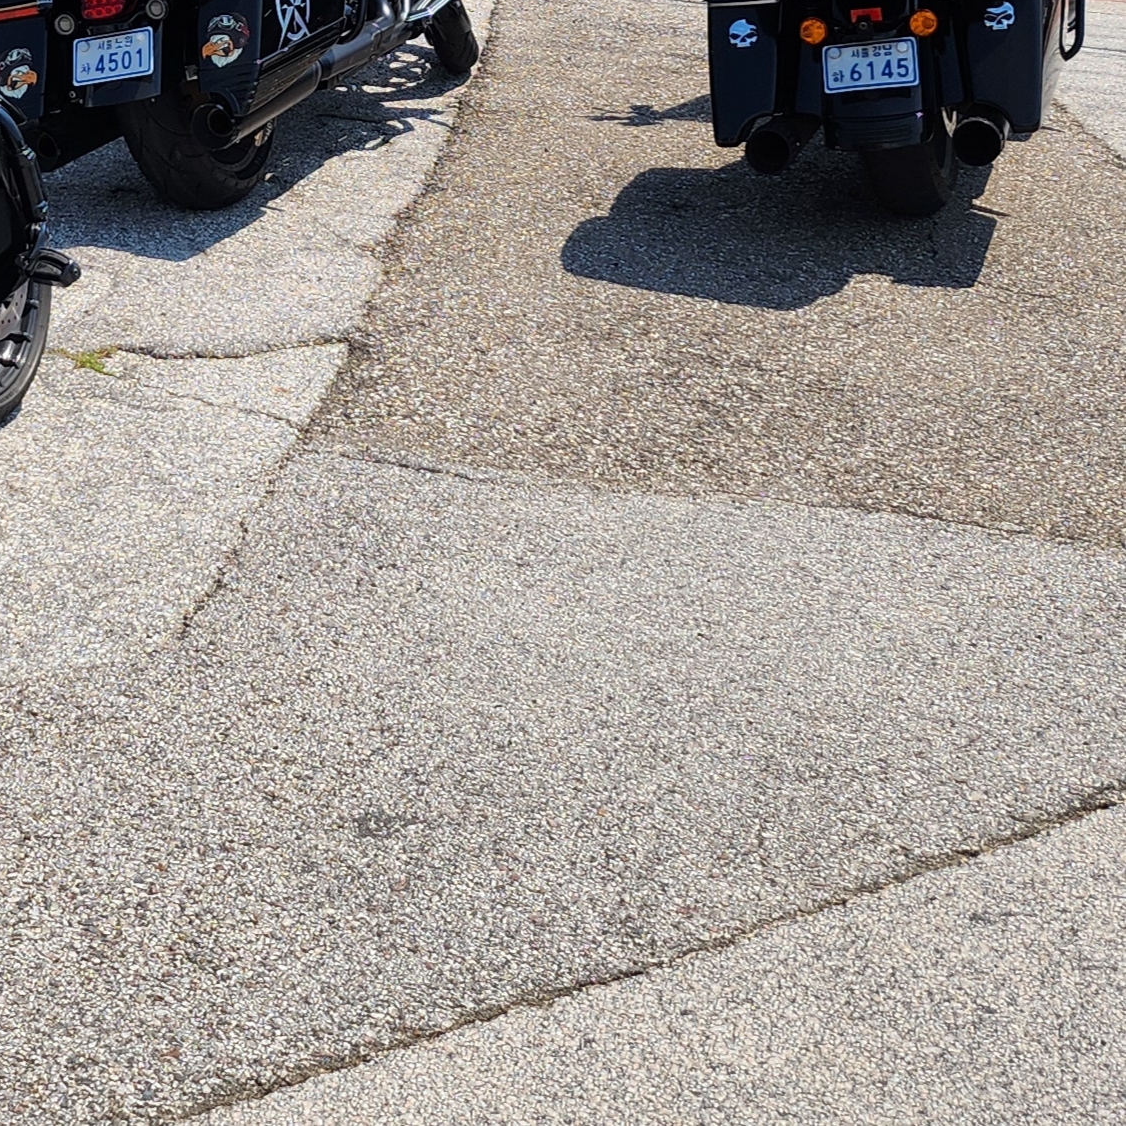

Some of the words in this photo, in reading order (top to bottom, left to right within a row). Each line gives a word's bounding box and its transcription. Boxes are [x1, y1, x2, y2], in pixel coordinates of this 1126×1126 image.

[95, 47, 142, 74] 4501
[832, 70, 845, 82] 하
[850, 58, 910, 82] 6145
